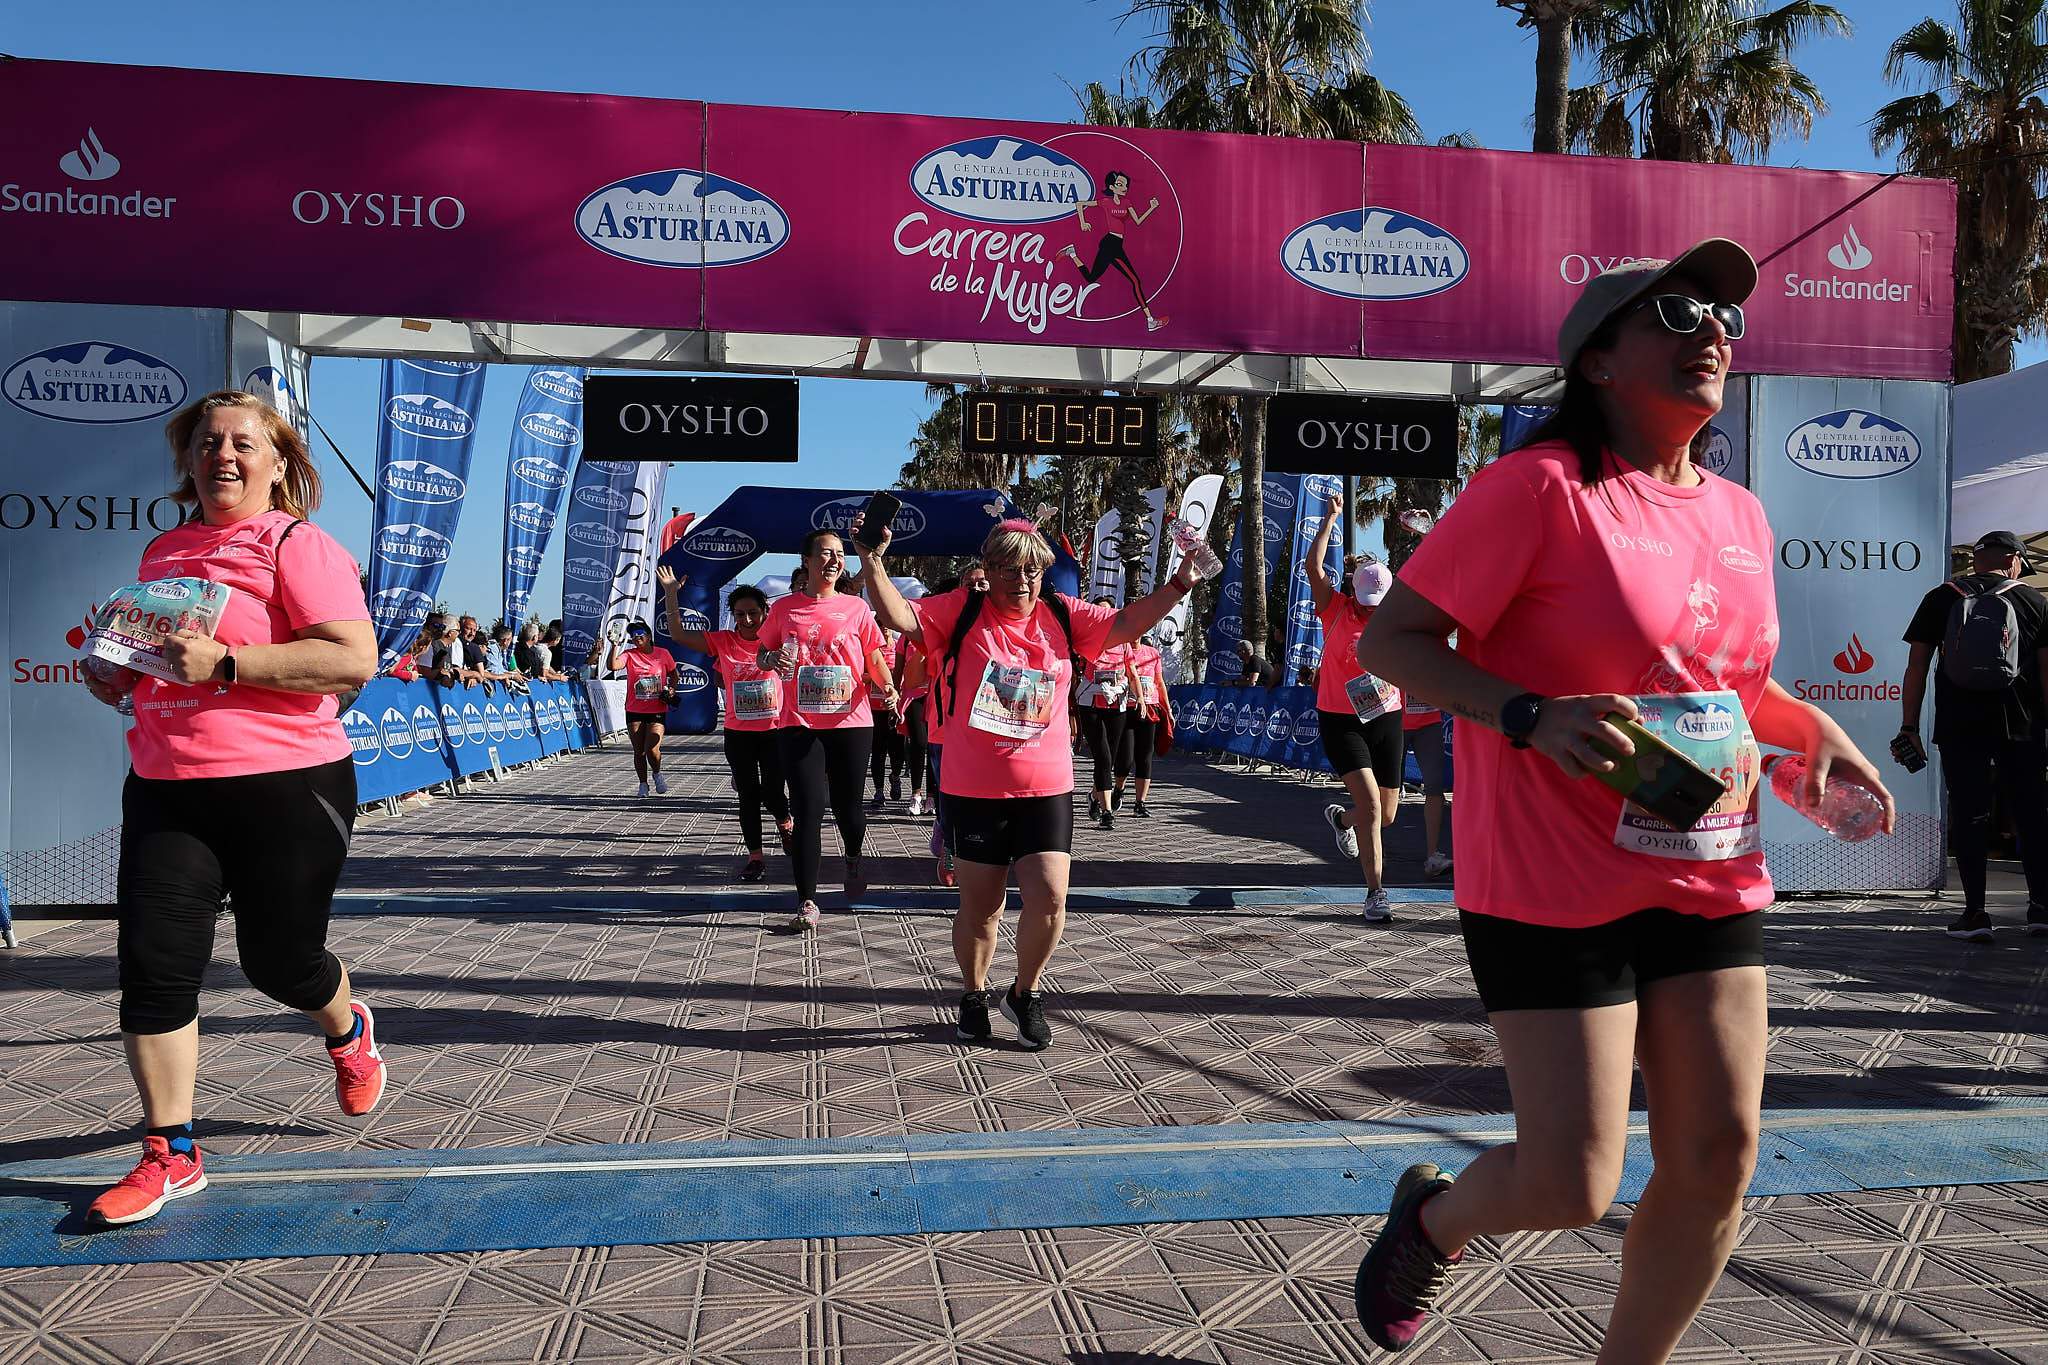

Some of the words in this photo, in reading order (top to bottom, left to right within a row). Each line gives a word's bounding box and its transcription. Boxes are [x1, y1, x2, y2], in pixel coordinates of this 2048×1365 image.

[954, 163, 1012, 175] CENTRAL
[1018, 167, 1076, 178] LECHERA
[925, 163, 1080, 204] ASTURIANA
[1, 184, 177, 218] Santander
[292, 190, 465, 230] OYSHO
[626, 200, 692, 213] CENTRAL
[592, 202, 773, 244] ASTURIANA
[893, 211, 1044, 264] Carrera
[1325, 237, 1384, 249] CENTRAL
[1390, 240, 1449, 251] LECHERA
[1295, 238, 1454, 279] ASTURIANA
[930, 262, 958, 293] de
[965, 264, 985, 294] la
[980, 261, 1101, 335] Mujer
[1785, 273, 1912, 302] Santander
[15, 370, 174, 404] ASTURIANA
[44, 369, 104, 379] CENTRAL
[109, 370, 168, 381] LECHERA
[390, 402, 467, 433] ASTURIANA
[525, 418, 576, 442] ASTURIANA
[619, 403, 769, 436] OYSHO
[1298, 419, 1432, 454] OYSHO
[1793, 434, 1911, 464] ASTURIANA
[1816, 432, 1859, 442] CENTRAL
[1862, 433, 1907, 443] LECHERA
[384, 469, 458, 497] ASTURIANA
[517, 462, 566, 485] ASTURIANA
[580, 490, 624, 508] ASTURIANA
[0, 493, 187, 532] OYSHO
[377, 534, 447, 559] ASTURIANA
[571, 527, 616, 544] ASTURIANA
[688, 537, 750, 552] ASTURIANA
[1611, 532, 1673, 557] OYSHO
[1780, 538, 1922, 572] OYSHO
[112, 634, 123, 644] DE
[123, 637, 132, 647] LA
[130, 629, 153, 642] 1799
[176, 699, 199, 708] MUJER
[1794, 680, 1902, 702] Santande
[1707, 817, 1729, 828] MUJER
[1638, 835, 1698, 851] OYSHO
